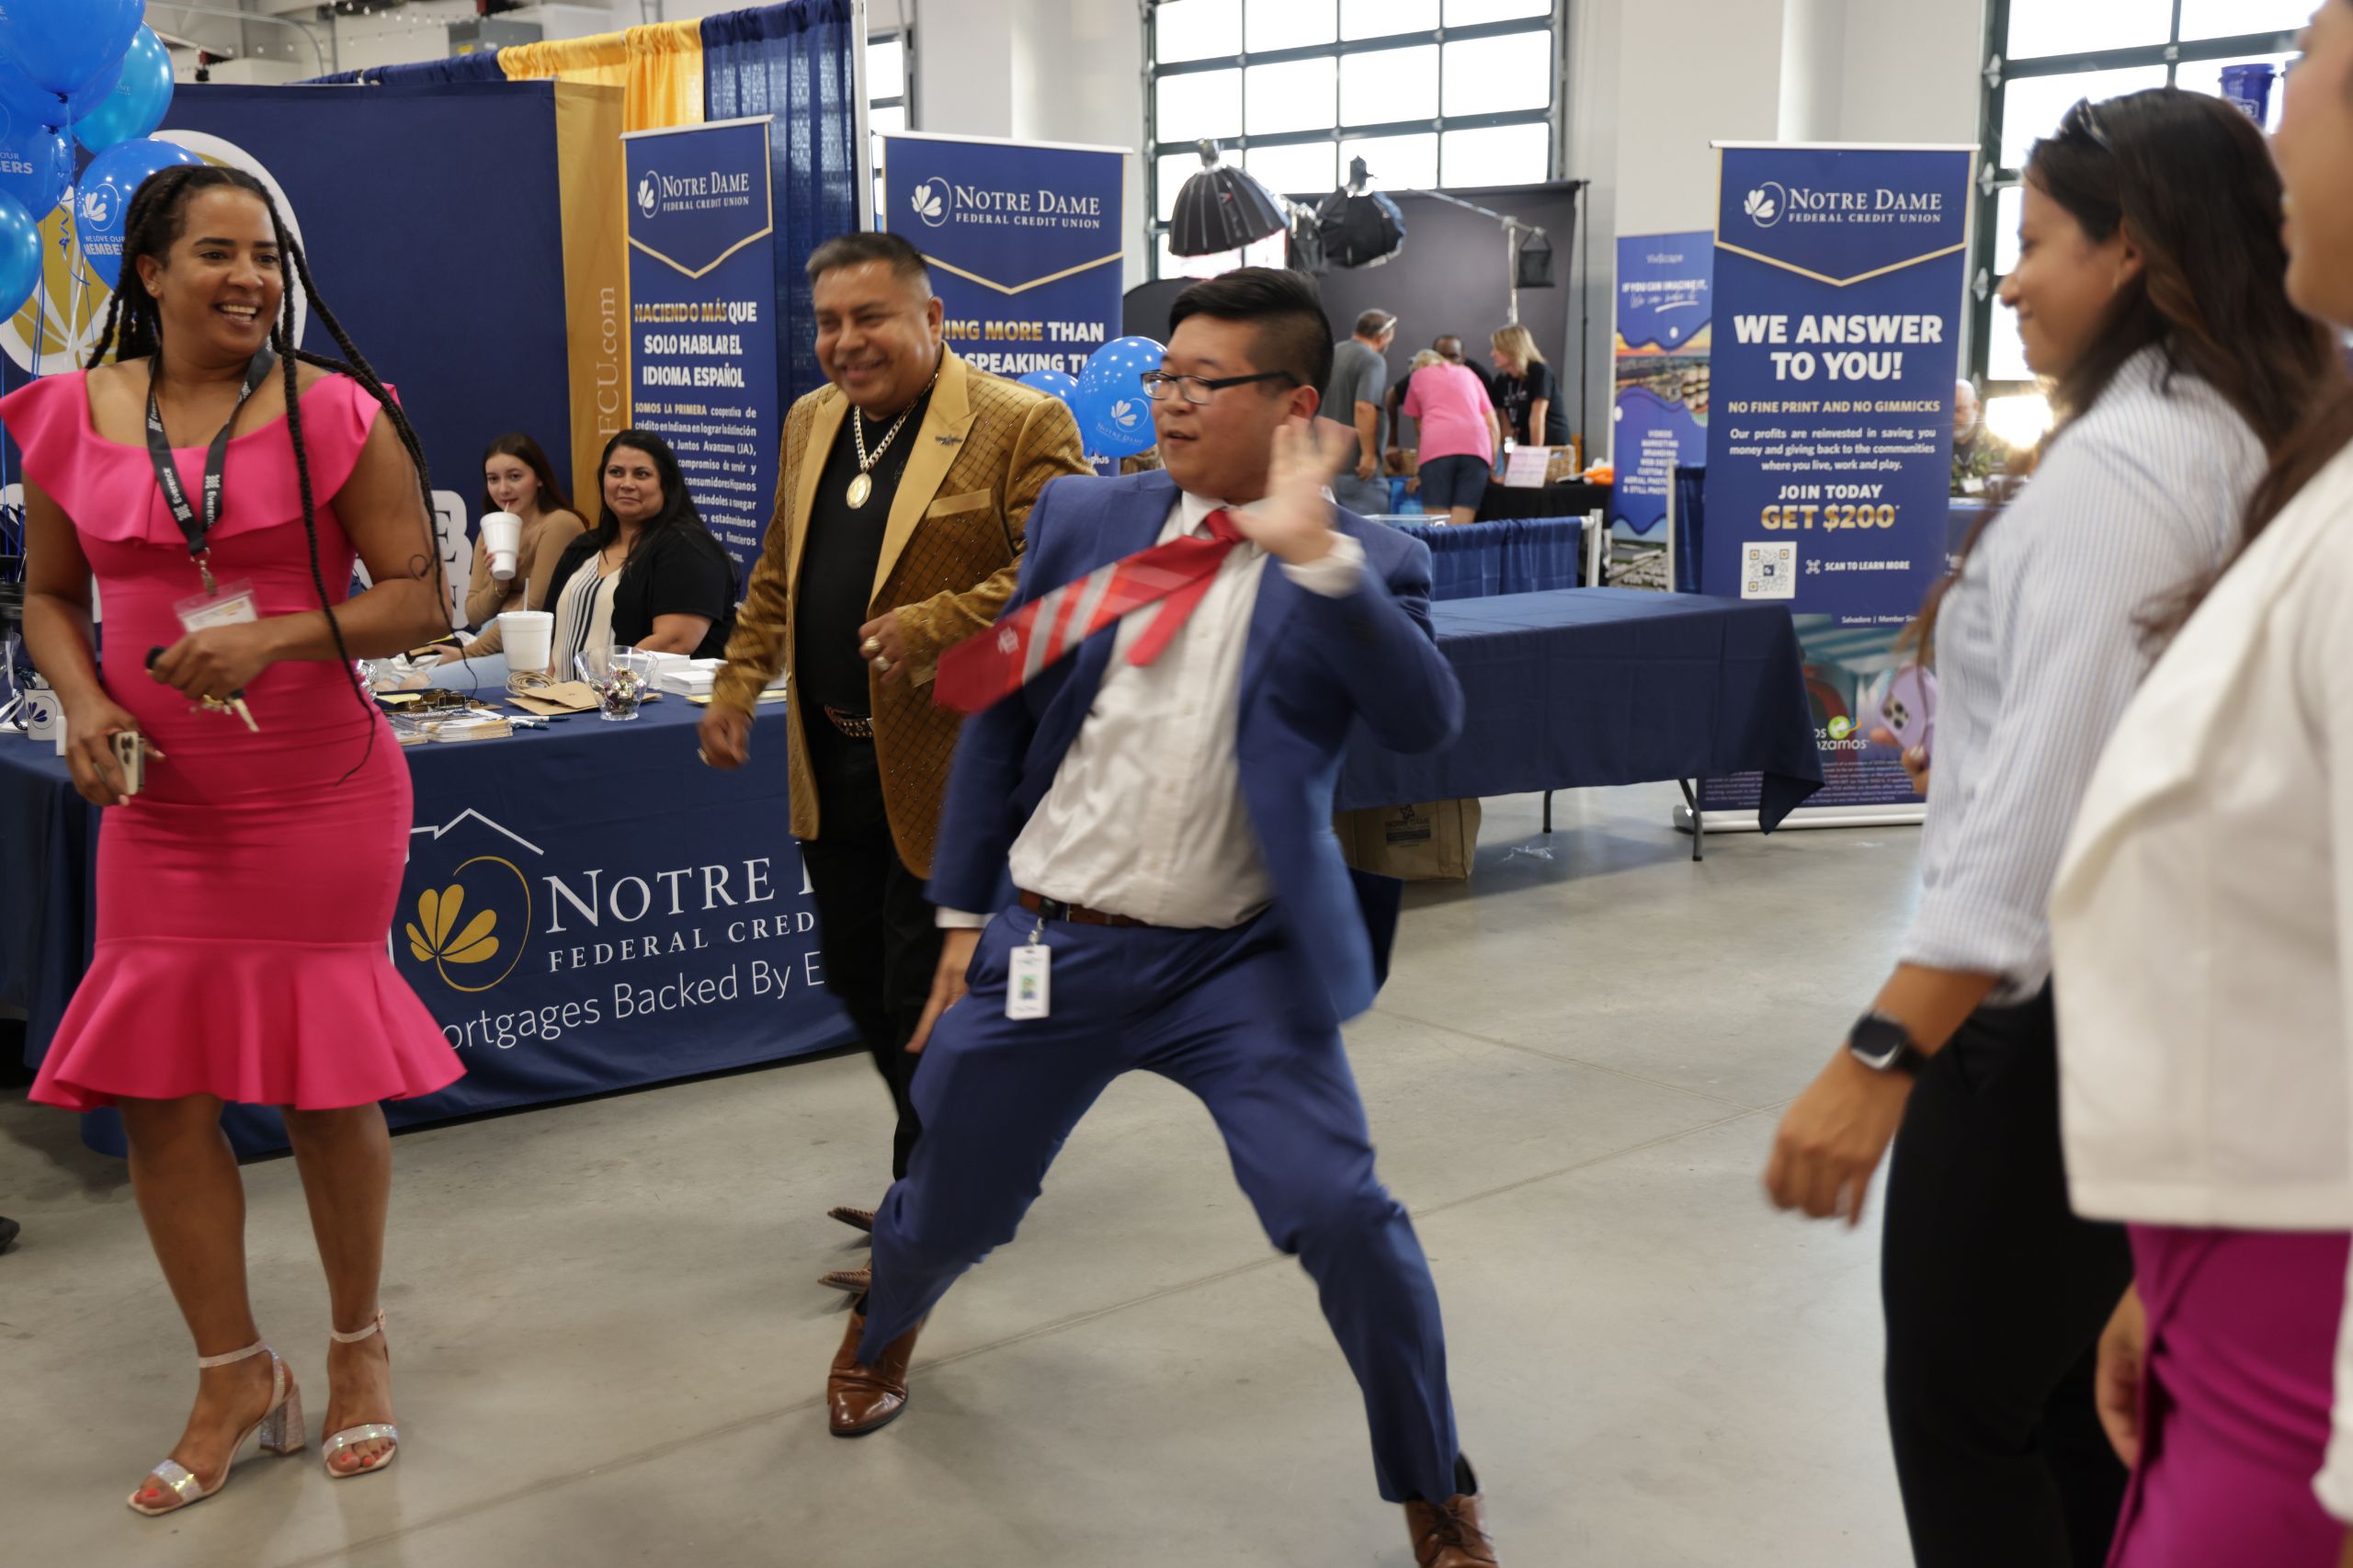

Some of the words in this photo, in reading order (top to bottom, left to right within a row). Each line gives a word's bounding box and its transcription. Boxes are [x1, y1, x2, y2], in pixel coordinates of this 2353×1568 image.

[662, 175, 707, 199] NOTRE
[710, 171, 750, 195] DAME
[663, 199, 695, 212] FEDERAL
[696, 197, 722, 210] CREDIT
[723, 196, 750, 208] UNION
[954, 185, 1031, 212] NOTRE
[1038, 189, 1101, 216] DAME
[1789, 187, 1869, 210] NOTRE
[1875, 188, 1942, 210] DAME
[955, 212, 1010, 225] FEDERAL
[1014, 216, 1058, 227] CREDIT
[1062, 218, 1101, 229] UNION
[1788, 212, 1844, 223] FEDERAL
[1847, 212, 1895, 223] CREDIT
[1899, 213, 1941, 223] UNION
[84, 244, 124, 256] MEMBE
[634, 302, 699, 323] HACIENDO
[701, 298, 727, 322] MÁS
[728, 301, 757, 325] QUE
[943, 320, 981, 340] ING
[984, 321, 1043, 341] MORE
[1047, 322, 1104, 342] THAN
[1733, 314, 1788, 344] WE
[1795, 314, 1943, 344] ANSWER
[644, 335, 677, 355] SOLO
[679, 335, 729, 355] HABLAR
[730, 335, 743, 355] EL
[965, 352, 1064, 374] SPEAKING
[1770, 352, 1815, 381] TO
[1822, 351, 1903, 381] YOU!
[642, 366, 692, 386] IDIOMA
[693, 362, 745, 388] ESPAÑOL
[635, 402, 661, 414] SOMOS
[664, 403, 673, 415] LA
[675, 403, 707, 415] PRIMERA
[745, 407, 756, 418] de
[1728, 402, 1748, 413] NO
[1751, 402, 1779, 413] FINE
[1781, 401, 1819, 413] PRINT
[1822, 401, 1851, 413] AND
[1853, 401, 1872, 413] NO
[1874, 401, 1941, 412] GIMMICKS
[635, 420, 659, 431] crédito
[660, 424, 667, 432] en
[692, 425, 699, 434] en
[700, 422, 722, 437] lograr
[1730, 428, 1749, 439] Our
[1754, 428, 1787, 441] profits
[1790, 431, 1807, 439] are
[1812, 427, 1863, 439] reinvested
[1867, 427, 1877, 438] in
[1881, 427, 1914, 440] saving
[1918, 430, 1937, 439] you
[676, 439, 699, 450] Juntos
[1729, 446, 1762, 457] money
[1765, 445, 1784, 455] and
[1785, 445, 1814, 457] giving
[1817, 443, 1840, 455] back
[1842, 445, 1853, 455] to
[1855, 444, 1871, 455] the
[1872, 443, 1936, 454] communities
[677, 459, 721, 471] compromiso
[1761, 460, 1791, 472] where
[1792, 462, 1811, 473] you
[1812, 460, 1833, 472] live,
[1835, 460, 1859, 471] work
[1859, 460, 1879, 471] and
[1879, 460, 1903, 472] play.
[1778, 485, 1821, 500] JOIN
[1824, 484, 1883, 499] TODAY
[1760, 505, 1820, 530] GET
[1824, 562, 1846, 572] SCAN
[1847, 562, 1858, 571] TO
[1859, 562, 1884, 571] LEARN
[1886, 561, 1910, 570] MORE
[542, 857, 776, 934] NOTRE
[549, 927, 709, 972] FEDERAL
[728, 911, 814, 943] CRED
[441, 997, 601, 1050] ortgages
[614, 965, 738, 1019] Backed
[752, 960, 791, 1006] By
